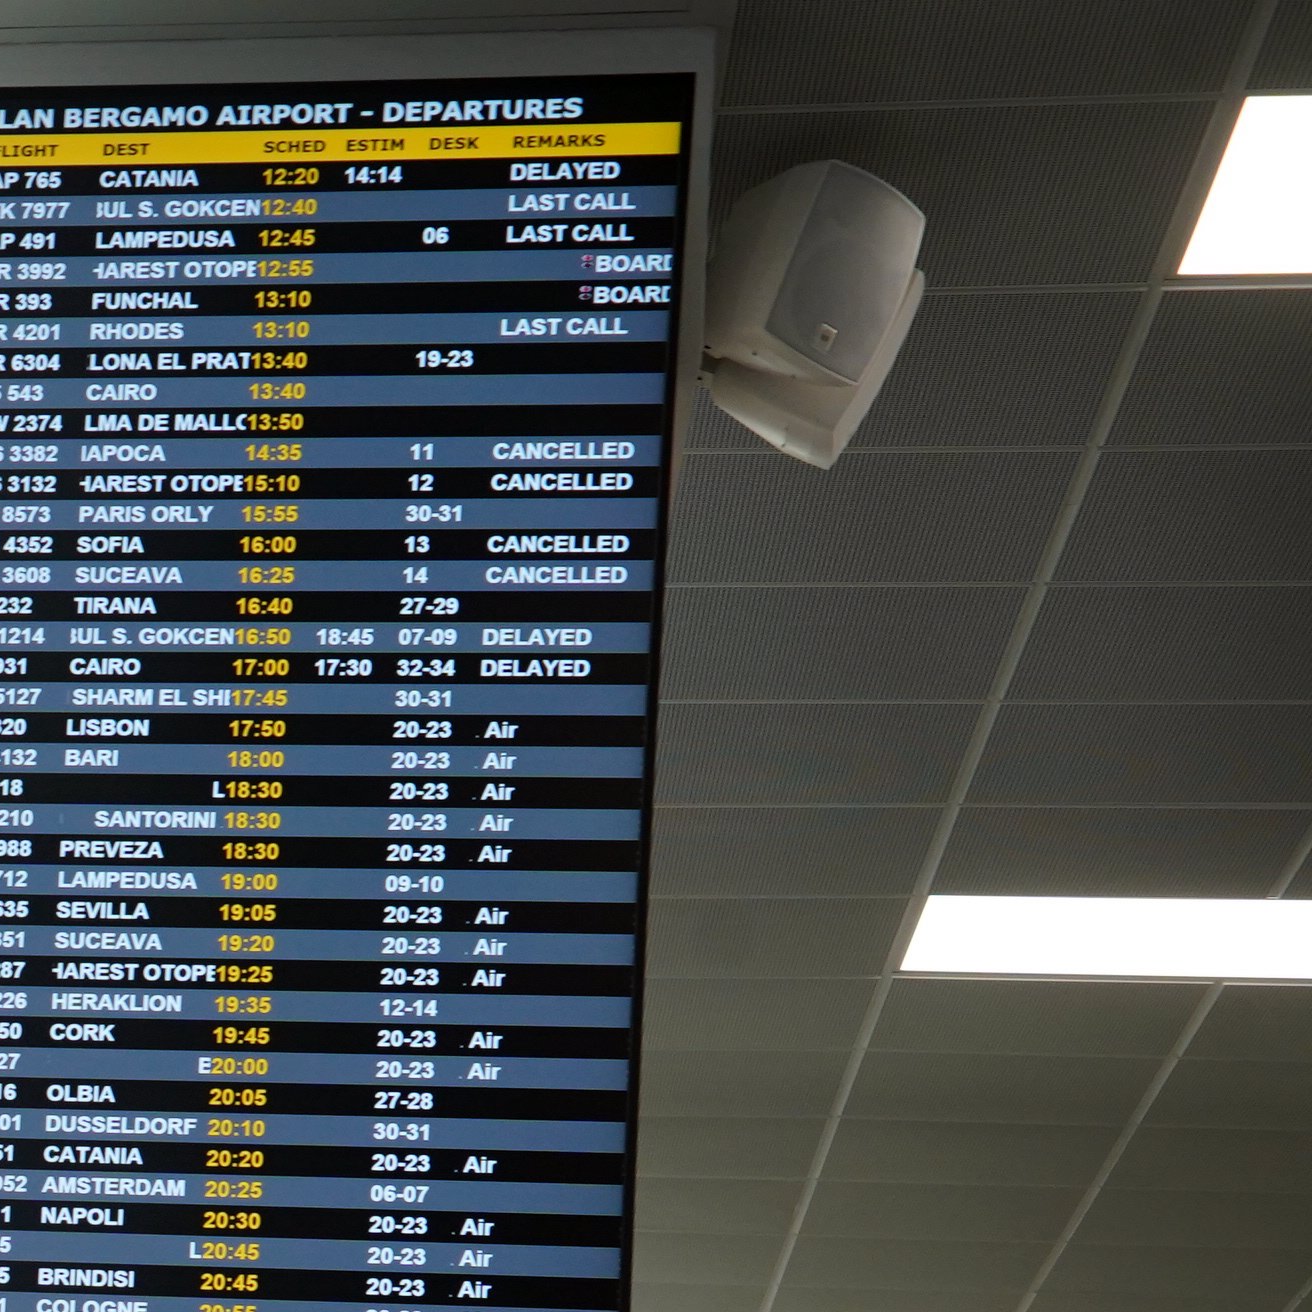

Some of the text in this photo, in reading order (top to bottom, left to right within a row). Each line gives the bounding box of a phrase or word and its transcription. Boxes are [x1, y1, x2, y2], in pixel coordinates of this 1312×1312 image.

[64, 106, 208, 128] BERGAMO
[216, 104, 353, 125] AIRPORT
[383, 98, 583, 122] DEPARTURES
[103, 143, 150, 156] DEST
[264, 140, 326, 153] SCHED
[347, 139, 404, 151] ESTIM
[430, 137, 478, 150] DESK
[514, 135, 605, 148] REMARKS
[25, 172, 61, 188] 765
[100, 170, 198, 187] CATANIA
[263, 168, 319, 185] 12:20
[345, 166, 402, 183] 14:14
[511, 162, 620, 180] DELAYED
[15, 294, 52, 310] 393
[92, 292, 198, 309] FUNCHAL
[255, 291, 311, 307] 13:10
[2, 506, 50, 522] 8573
[79, 506, 141, 522] PARIS
[152, 506, 213, 522] ORLY
[243, 506, 297, 521] 15:55
[406, 505, 462, 521] 30-31
[4, 537, 52, 553] 4352
[77, 537, 144, 553] SOFIA
[240, 537, 296, 553] 16:00
[405, 536, 429, 552] 13
[487, 536, 629, 552] CANCELLED
[70, 658, 141, 675] CAIRO
[233, 659, 289, 675] 17:00
[315, 659, 372, 676] 17:30
[397, 660, 455, 676] 32-34
[481, 660, 590, 676] DELAYED
[67, 719, 149, 736] LISBON
[230, 720, 285, 737] 17:50
[393, 721, 452, 738] 20-23
[484, 722, 518, 738] Air
[52, 993, 182, 1011] HERAKLION
[216, 997, 271, 1013] 19:35
[380, 999, 438, 1016] 12-14
[41, 1177, 185, 1196] AMSTERDAM
[205, 1181, 262, 1198] 20:25
[371, 1185, 429, 1202] 06-07
